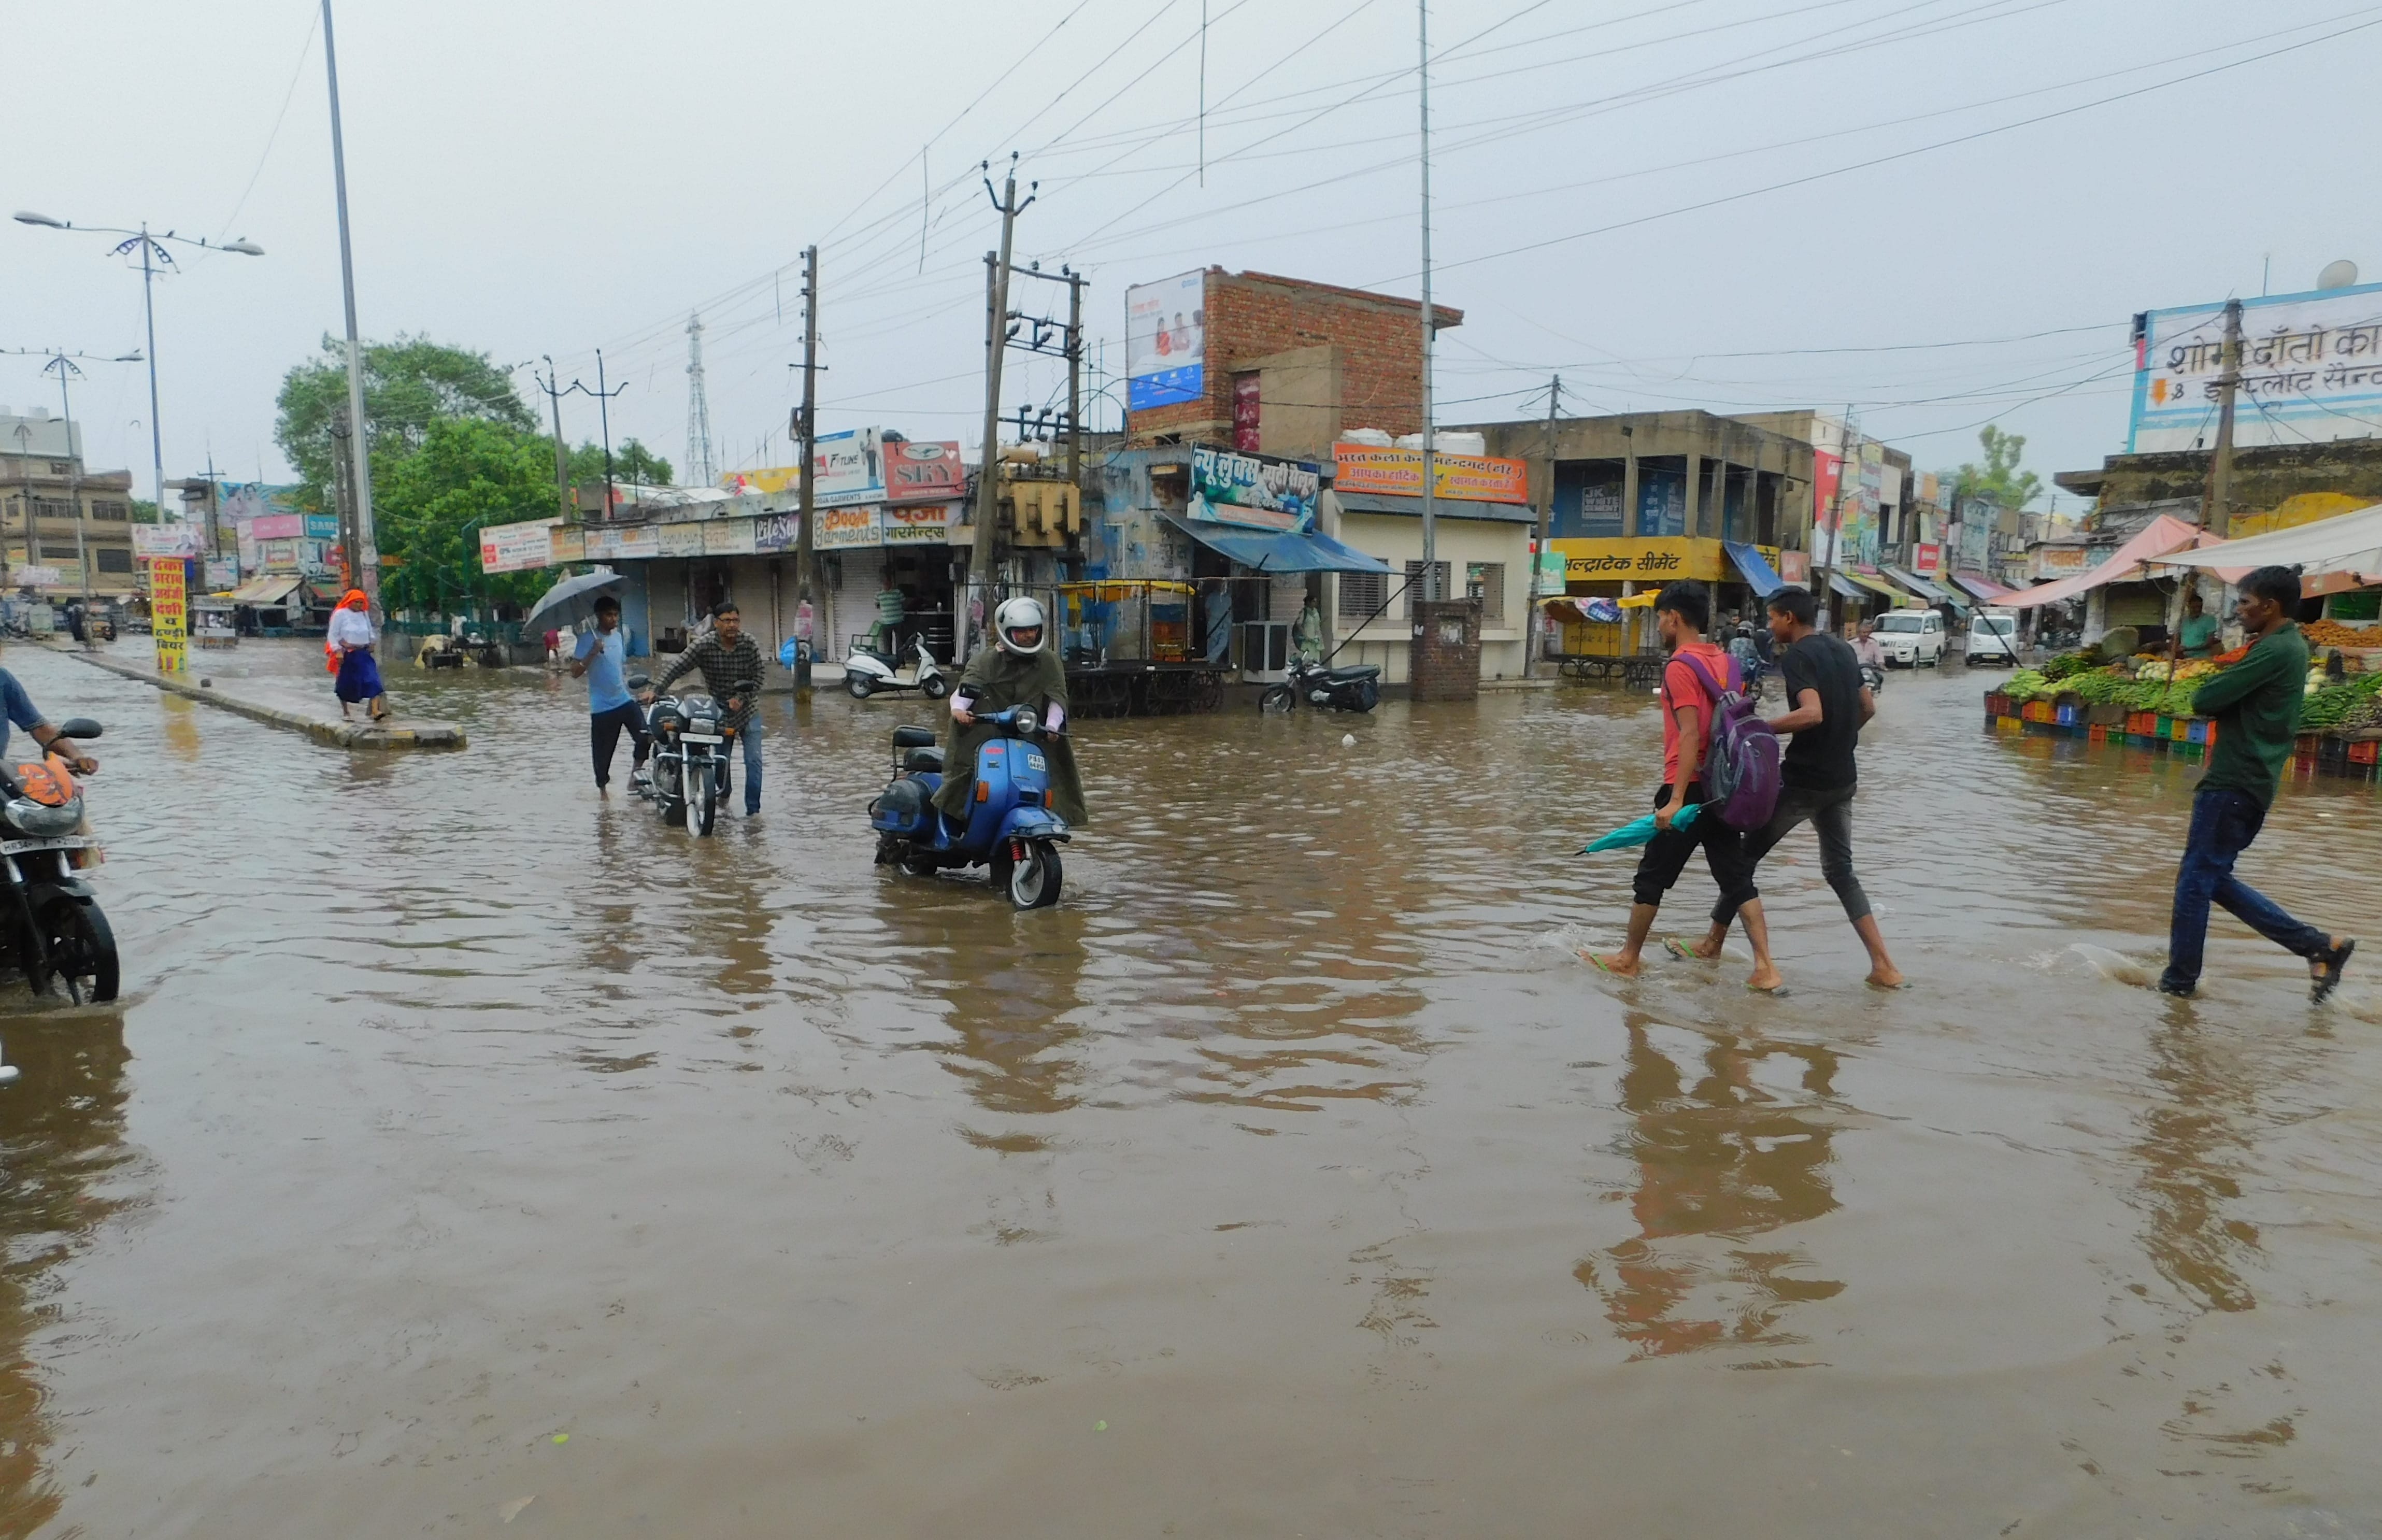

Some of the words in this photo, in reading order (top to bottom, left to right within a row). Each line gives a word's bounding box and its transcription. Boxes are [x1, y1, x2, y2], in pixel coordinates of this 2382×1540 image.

[1371, 454, 1399, 462] कला
[1350, 467, 1386, 479] आपका
[830, 493, 861, 503] GARMENTS
[1585, 488, 1604, 497] JK
[1585, 497, 1619, 506] WHITE
[824, 507, 870, 530] Pooja
[892, 505, 948, 523] पूजा
[813, 516, 880, 547] Garments
[1636, 551, 1682, 571] सीमेंट
